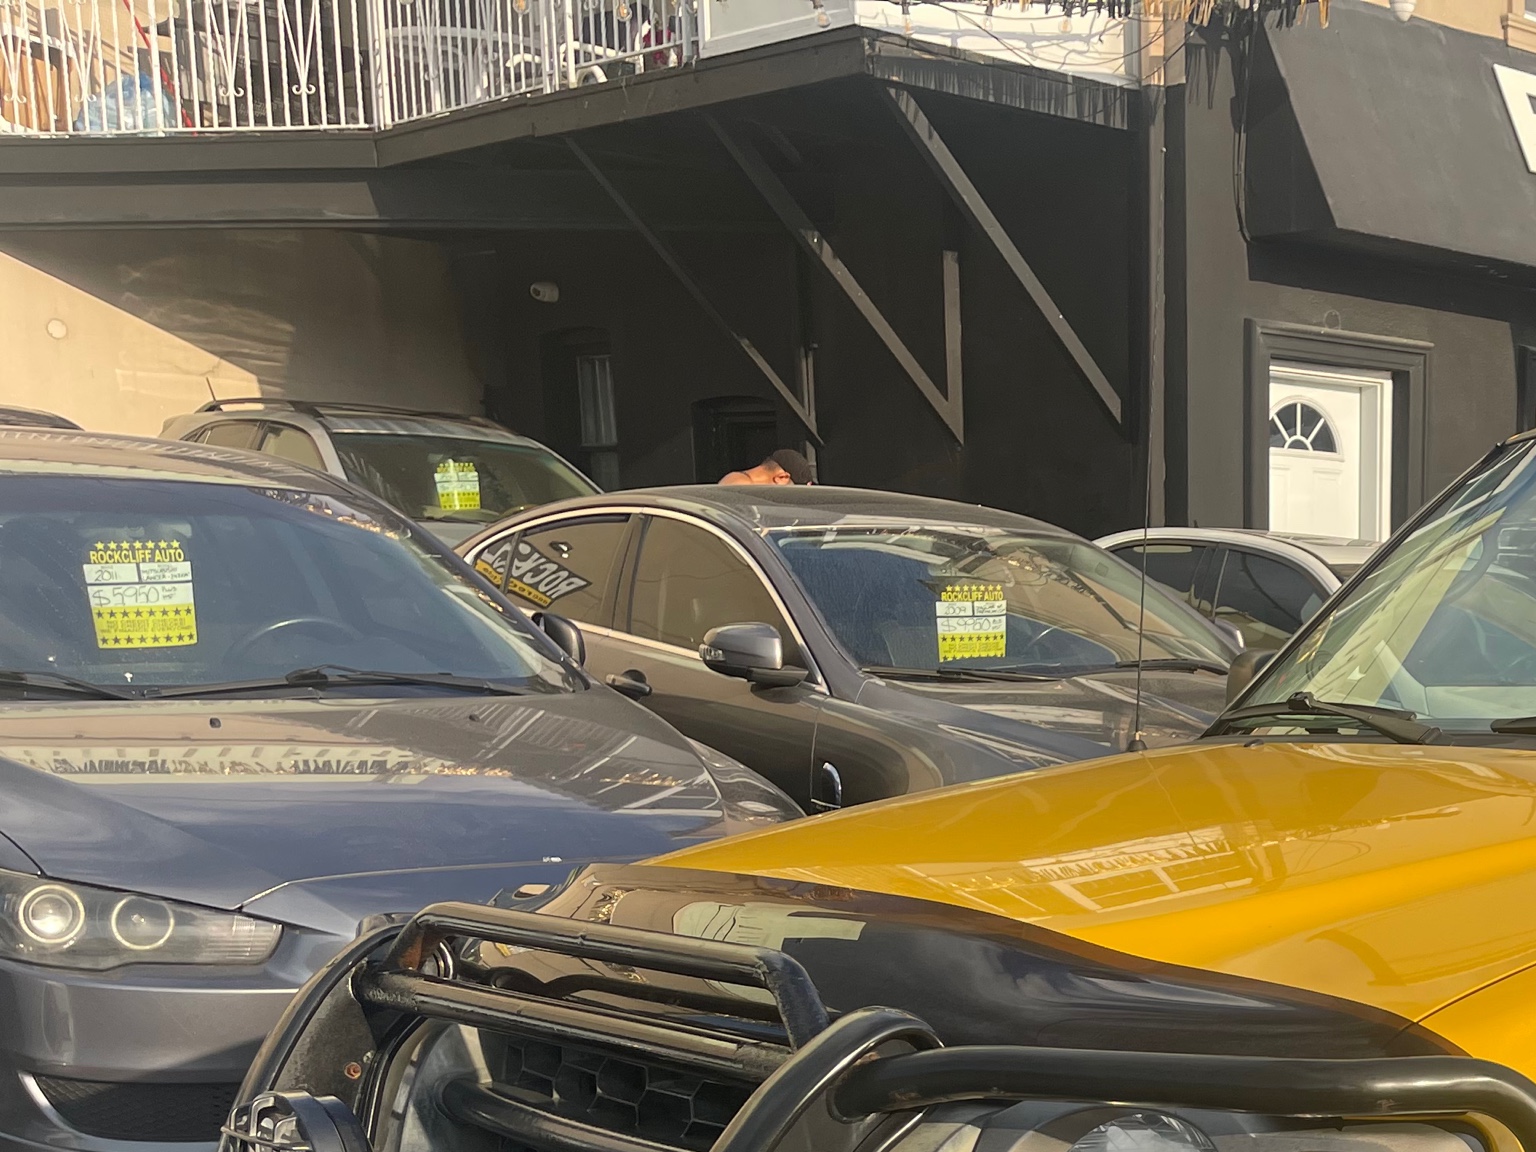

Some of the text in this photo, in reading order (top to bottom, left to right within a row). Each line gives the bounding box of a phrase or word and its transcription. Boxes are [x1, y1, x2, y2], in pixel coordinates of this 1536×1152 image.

[89, 549, 184, 564] ROCKCLIFF AUTO
[984, 591, 1003, 601] AUTO
